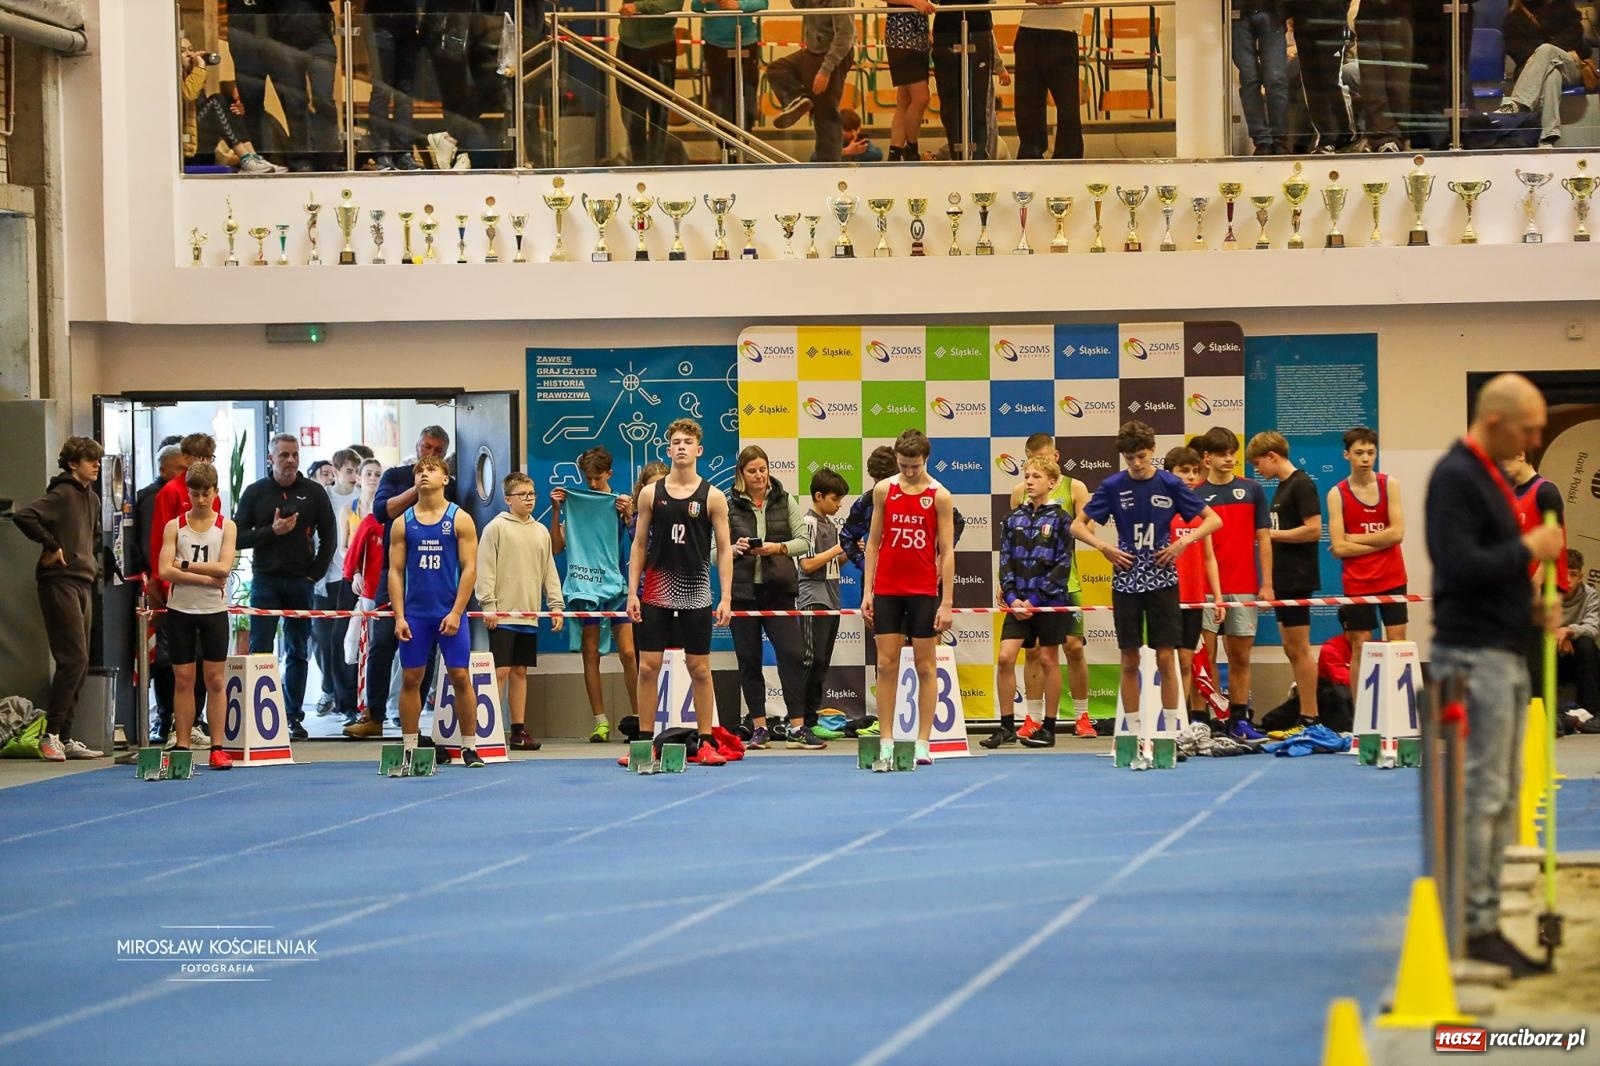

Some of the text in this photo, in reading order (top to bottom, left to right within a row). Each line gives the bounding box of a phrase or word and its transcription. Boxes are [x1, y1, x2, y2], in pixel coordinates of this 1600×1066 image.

[764, 346, 795, 355] ZSOMS
[822, 346, 854, 358] Śląskie.
[891, 346, 922, 355] ZSOMS
[950, 346, 982, 358] Śląskie.
[1019, 345, 1050, 354] ZSOMS
[1079, 345, 1111, 356] Śląskie.
[1149, 343, 1180, 351] ZSOMS
[1208, 341, 1241, 353] Śląskie.
[536, 355, 572, 363] ZAWSZE
[537, 368, 560, 376] GRAJ
[543, 380, 585, 388] HISTORIA
[537, 392, 591, 400] PRAWDZIWA
[759, 403, 790, 415] Śląskie.
[828, 403, 858, 412] ZSOMS
[886, 403, 918, 415] Śląskie.
[955, 403, 987, 412] ZSOMS
[1015, 402, 1047, 414] Śląskie.
[1084, 401, 1116, 410] ZSOMS
[1144, 400, 1177, 412] Śląskie.
[1212, 399, 1244, 408] ZSOMS
[768, 460, 796, 470] SOMS
[951, 460, 983, 472] Śląskie.
[1080, 458, 1112, 470] Śląskie.
[1567, 451, 1589, 504] Bank Polski
[892, 513, 925, 525] PIAST
[963, 516, 988, 525] SOMS
[671, 523, 686, 544] 42
[890, 527, 926, 550] 758
[1134, 522, 1155, 551] 54
[191, 544, 209, 562] 71
[418, 554, 441, 570] 413
[953, 573, 985, 585] Śląskie.
[958, 630, 990, 639] ZSOMS
[826, 688, 858, 700] Śląskie.
[960, 687, 986, 698] ląskie.
[1365, 664, 1380, 730] 1
[1397, 663, 1418, 730] 1
[473, 673, 495, 739] 5
[899, 667, 917, 733] 3
[933, 667, 956, 733] 3
[224, 676, 243, 741] 6
[253, 675, 280, 741] 6
